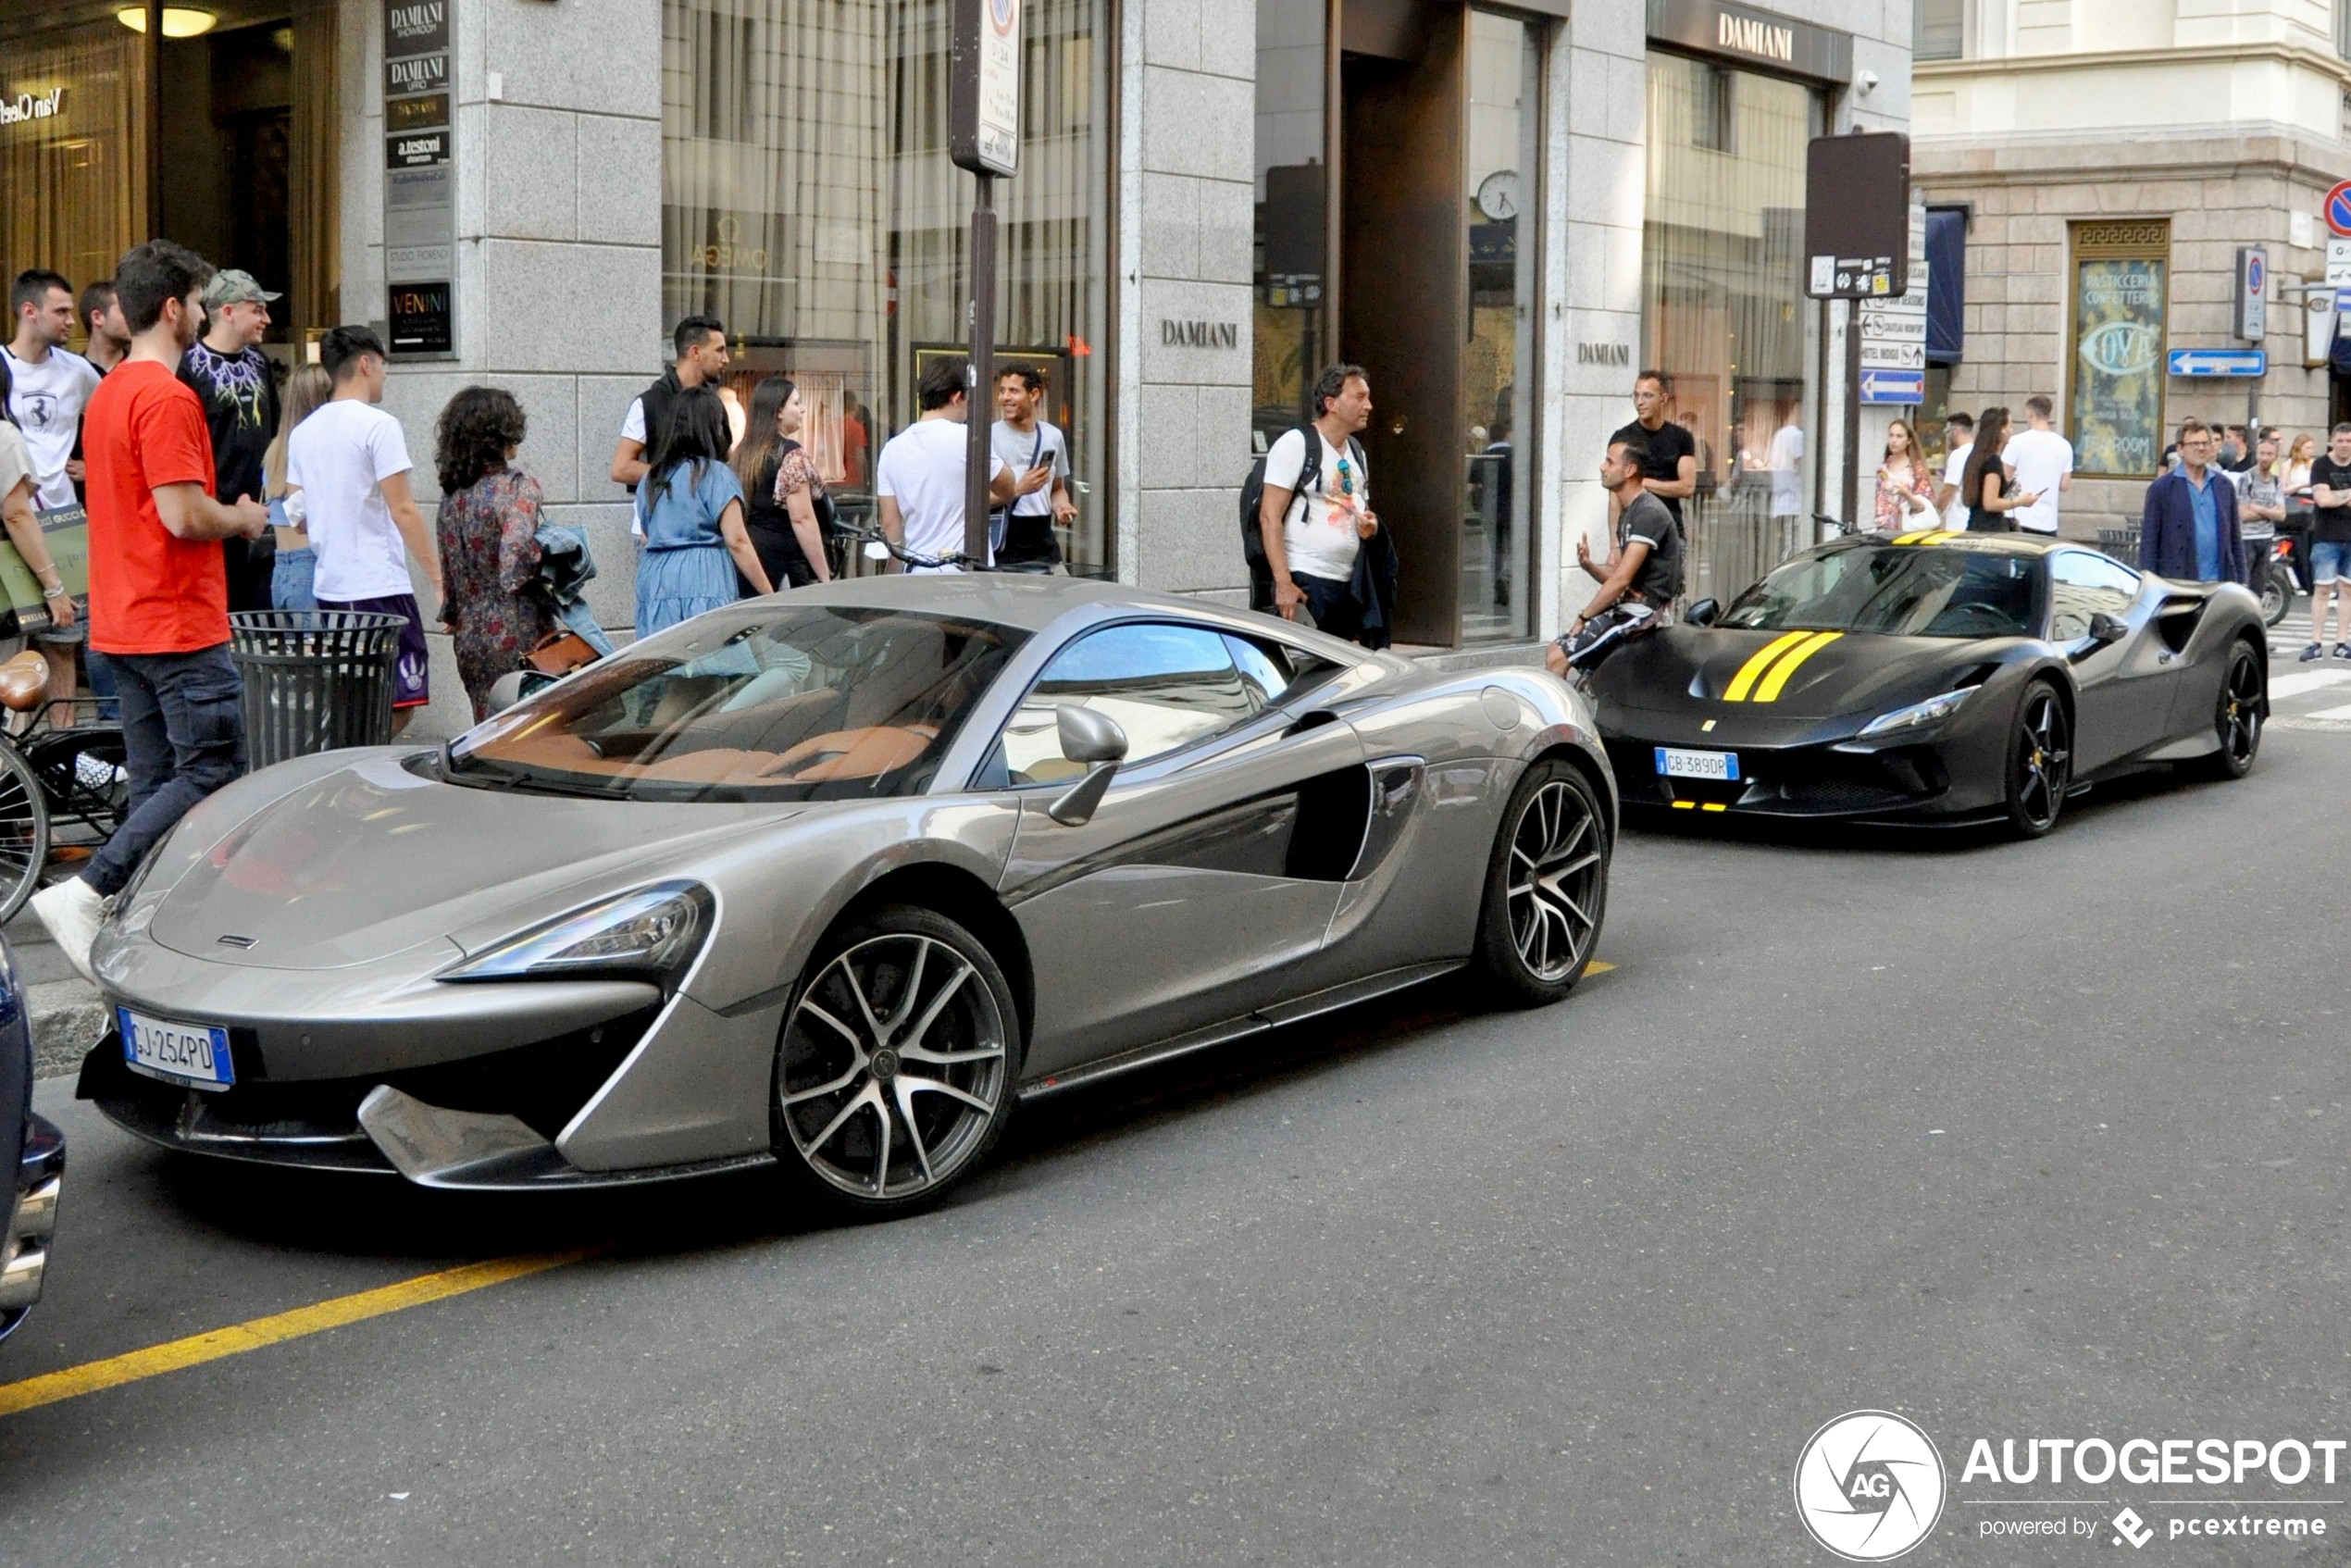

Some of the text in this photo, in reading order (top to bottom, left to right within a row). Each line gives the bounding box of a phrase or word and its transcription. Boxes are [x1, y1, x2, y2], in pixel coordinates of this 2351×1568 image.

[392, 2, 442, 29] DAMIANI
[1719, 12, 1793, 62] DAMIANI
[392, 57, 443, 84] DAMIANI
[398, 135, 441, 156] a.testoni
[2085, 274, 2158, 289] PASTICCERIA
[393, 292, 446, 315] VENINI
[2085, 290, 2158, 305] CONFETTERIA
[1163, 319, 1238, 348] DAMIANI
[1578, 342, 1629, 367] DAMIANI
[1861, 347, 1899, 361] HOTEL INDIGO
[2113, 436, 2150, 454] ROOM
[53, 510, 81, 524] GUCCI
[155, 1029, 213, 1070] 254PD
